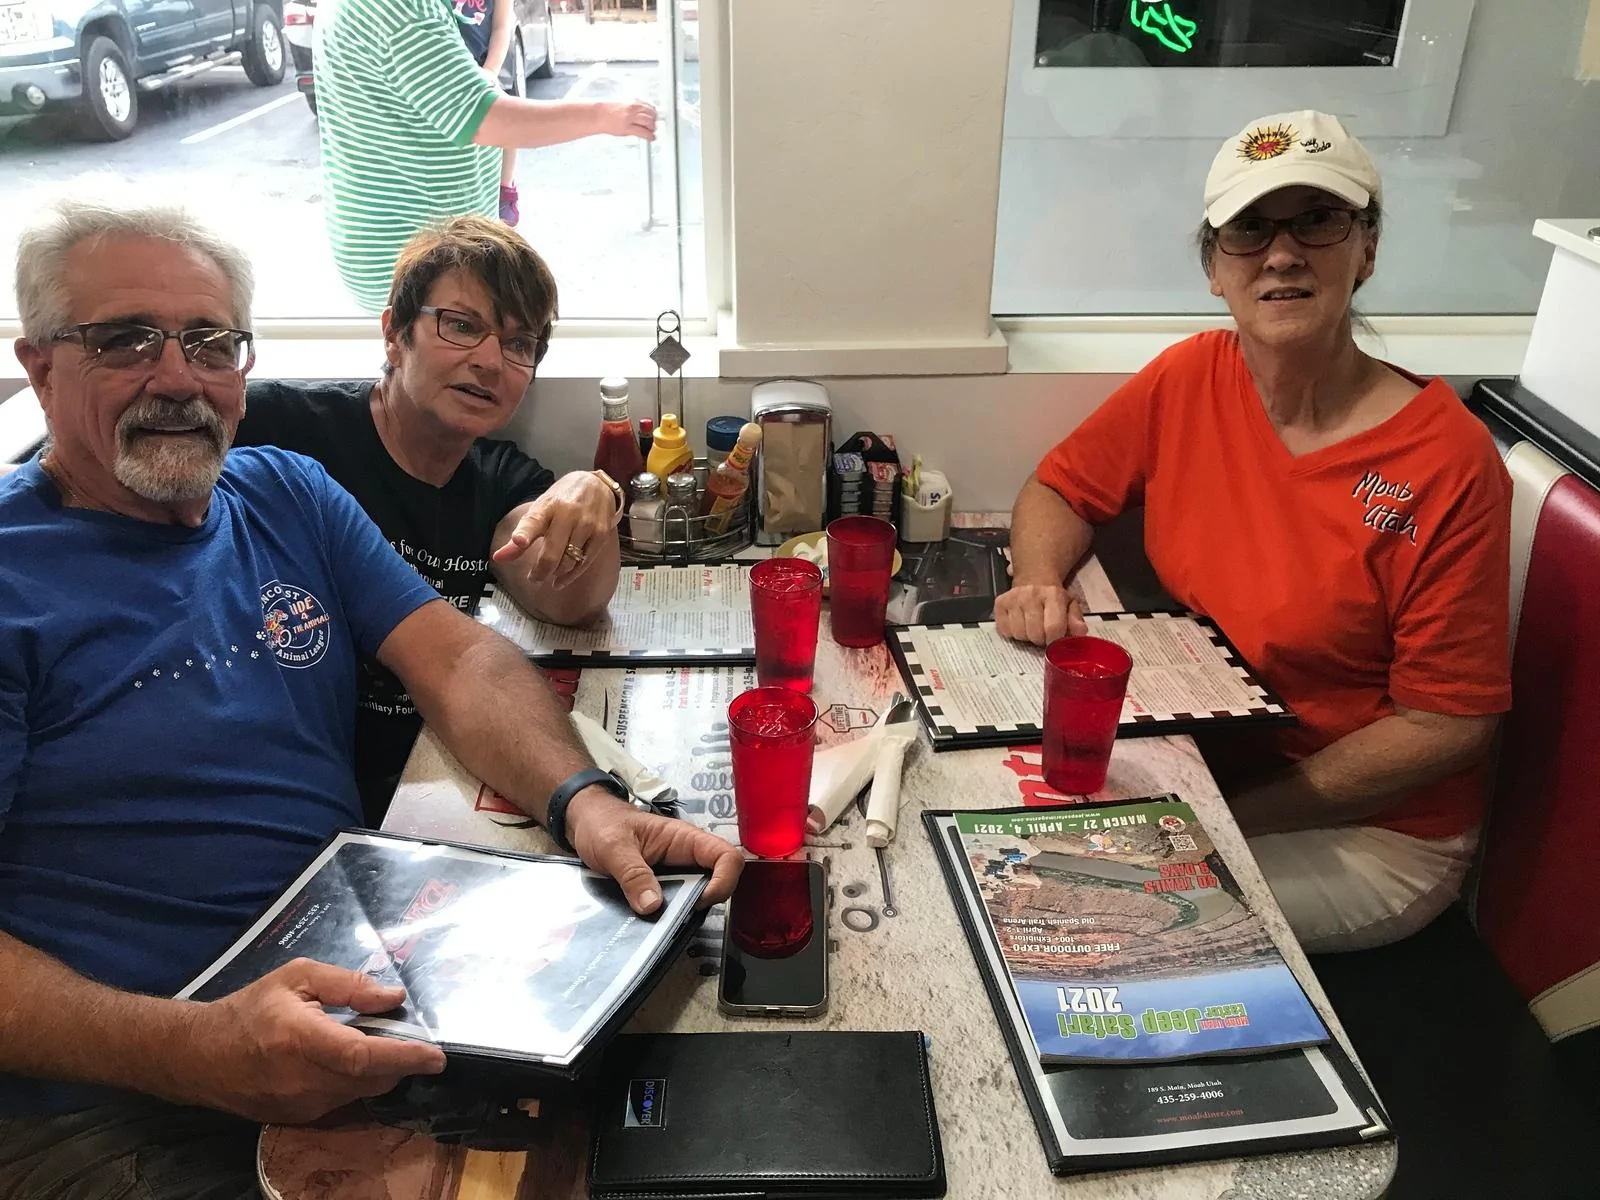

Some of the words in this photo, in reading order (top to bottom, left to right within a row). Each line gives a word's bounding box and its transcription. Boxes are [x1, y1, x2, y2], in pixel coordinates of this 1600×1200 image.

[1351, 469, 1413, 507] Moab
[1362, 503, 1418, 547] Utah
[276, 649, 309, 661] Animal
[309, 629, 325, 657] League
[616, 681, 633, 737] SUSPENSION
[835, 707, 846, 730] LIFETIME
[1029, 821, 1063, 833] APRIL
[1083, 819, 1098, 830] 27
[1103, 814, 1147, 828] MARCH
[974, 824, 1004, 834] 2021
[1159, 863, 1197, 878] DAYS
[1143, 879, 1193, 894] TRAILS
[1197, 875, 1218, 889] 40
[278, 903, 321, 948] 435-259-4006
[1003, 917, 1026, 925] Arena
[1027, 917, 1046, 925] Trail
[1047, 916, 1080, 925] Spanish
[1080, 917, 1095, 925] Old
[1023, 925, 1043, 934] April
[1009, 934, 1052, 943] Exhibitors
[1054, 934, 1075, 942] 100+
[1013, 943, 1040, 952] EXPO
[1043, 943, 1092, 953] OUTDOOR
[1094, 942, 1120, 952] FREE
[1057, 986, 1123, 1014] 2021
[1203, 1002, 1247, 1019] Easter
[1057, 1012, 1138, 1040] Safari
[1141, 1007, 1201, 1035] Jeep
[1160, 1085, 1167, 1093] S.
[1168, 1082, 1187, 1093] Main,
[1187, 1081, 1205, 1090] Moab
[1206, 1079, 1223, 1087] Utah
[641, 1081, 655, 1126] DISCOVER
[1156, 1089, 1224, 1105] 435-259-4006
